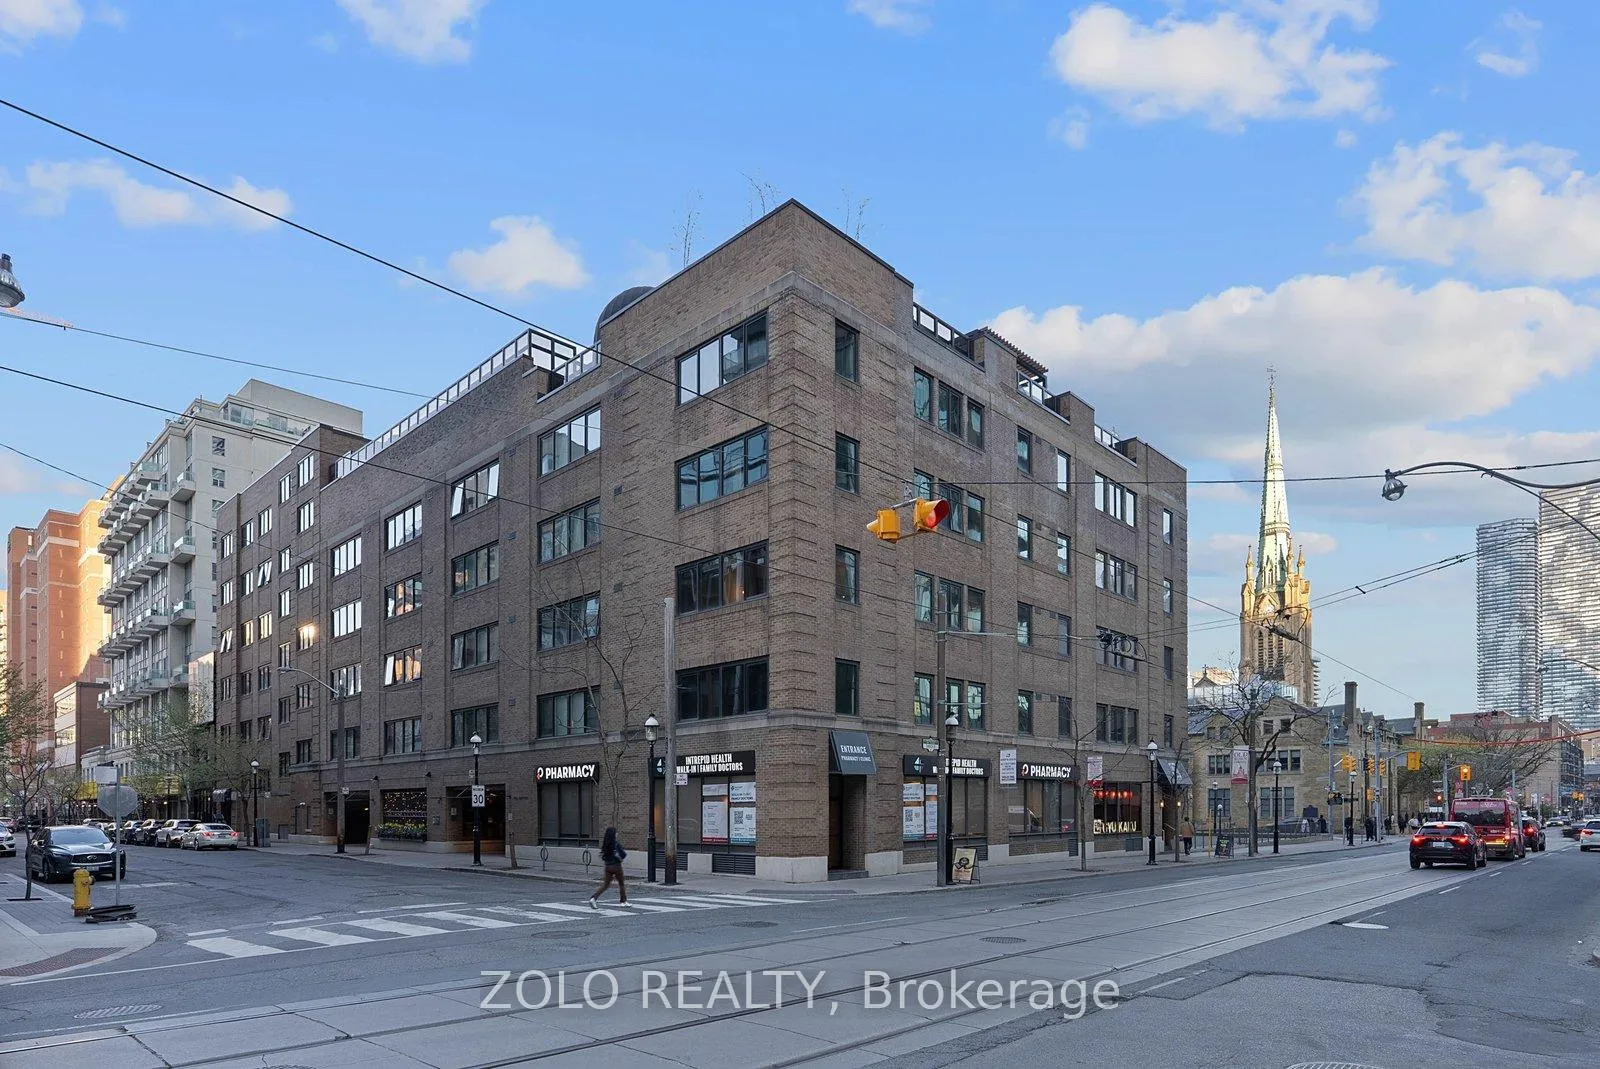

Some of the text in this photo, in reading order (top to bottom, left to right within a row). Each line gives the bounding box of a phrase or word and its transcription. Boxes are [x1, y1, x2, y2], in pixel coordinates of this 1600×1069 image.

[840, 744, 867, 754] ENTRANCE
[685, 753, 733, 765] INTREPID HEALTH
[961, 759, 977, 768] HEALTH
[545, 764, 595, 780] PHARMACY
[676, 765, 697, 774] WALK-IN
[700, 763, 717, 773] FAMILY
[717, 762, 743, 772] DOCTORS
[1030, 765, 1072, 778] PHARMACY
[473, 794, 483, 804] 30
